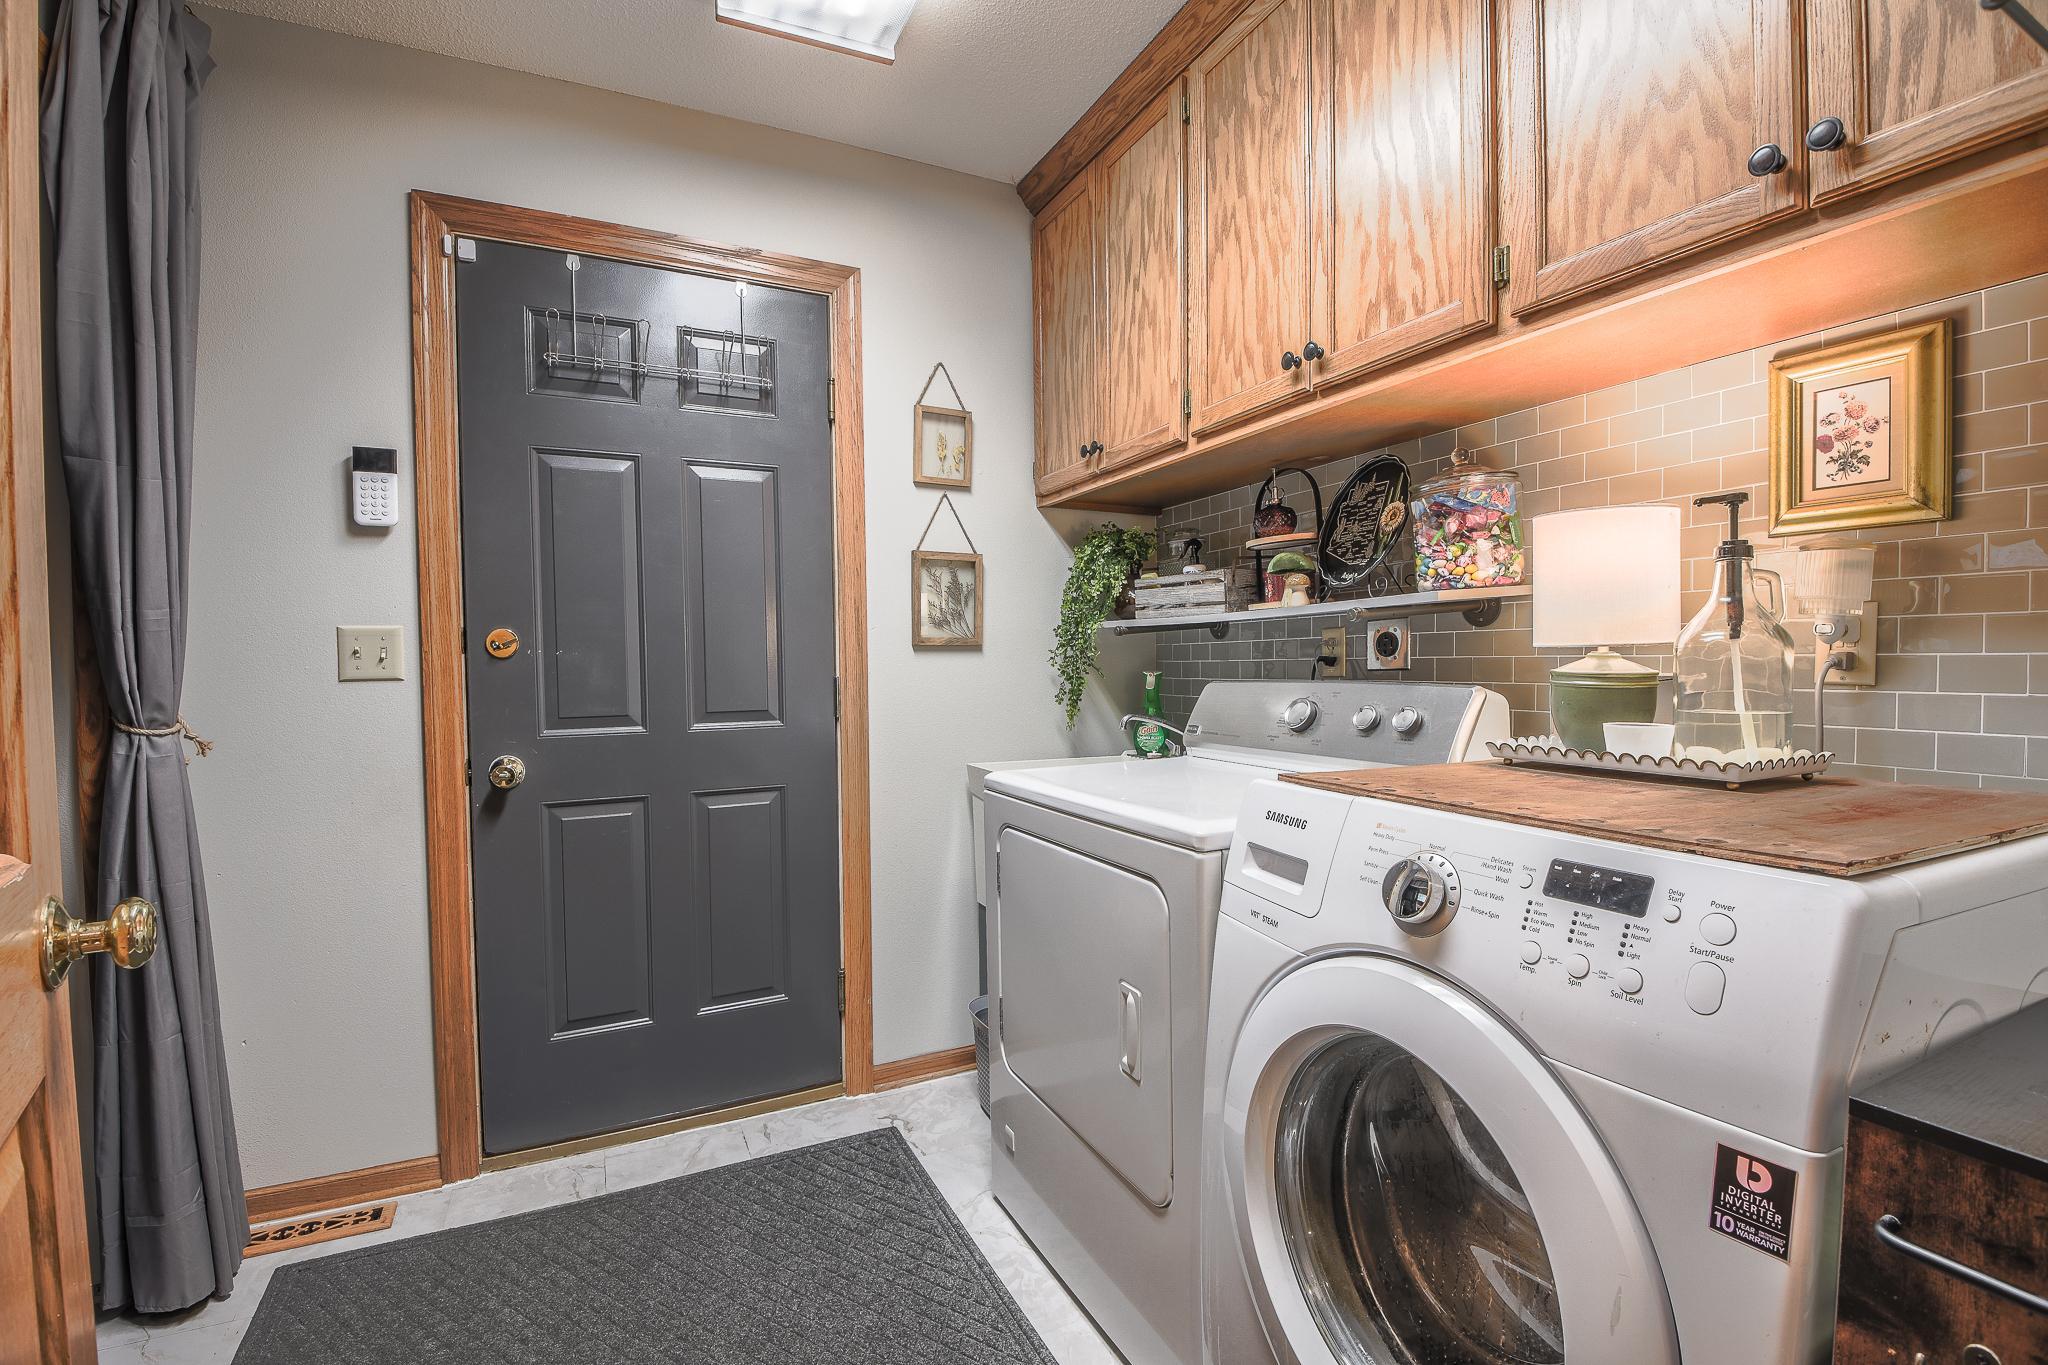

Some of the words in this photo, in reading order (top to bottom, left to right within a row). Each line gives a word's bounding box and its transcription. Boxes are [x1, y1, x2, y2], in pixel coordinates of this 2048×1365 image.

[1265, 810, 1308, 830] SAMSUNG
[1429, 843, 1446, 852] Normal
[1490, 856, 1514, 867] Delicates
[1497, 865, 1512, 874] Wash
[1522, 864, 1537, 873] Steam
[1495, 875, 1509, 884] Wool
[1473, 888, 1488, 898] Quick
[1489, 892, 1504, 901] Wash
[1668, 888, 1685, 898] Delay
[1668, 895, 1683, 903] Start
[1710, 900, 1736, 912] Power
[1470, 905, 1500, 919] Rinse+Spin
[1533, 909, 1548, 918] Warm
[1581, 912, 1593, 920] High
[1262, 914, 1279, 928] STEAM
[1530, 917, 1540, 925] Eco
[1540, 920, 1555, 928] Warm
[1579, 921, 1600, 931] Medium
[1528, 925, 1541, 934] Cold
[1577, 929, 1588, 937] Low
[1632, 923, 1650, 933] Heavy
[1630, 933, 1651, 943] Normal
[1583, 940, 1595, 948] Spin
[1626, 951, 1641, 960] Light
[1689, 945, 1735, 964] Start/Pause
[1519, 962, 1536, 974] Temp.
[1568, 977, 1582, 987] Spin
[1610, 989, 1623, 1000] Soil
[1625, 994, 1644, 1006] Level
[1728, 1185, 1776, 1212] DIGITAL
[1721, 1192, 1782, 1224] INVERTER
[1720, 1201, 1782, 1229] TECHNOLOGY
[1714, 1211, 1735, 1233] 10
[1736, 1221, 1756, 1233] YEAR
[1736, 1228, 1785, 1254] WARRANTY
